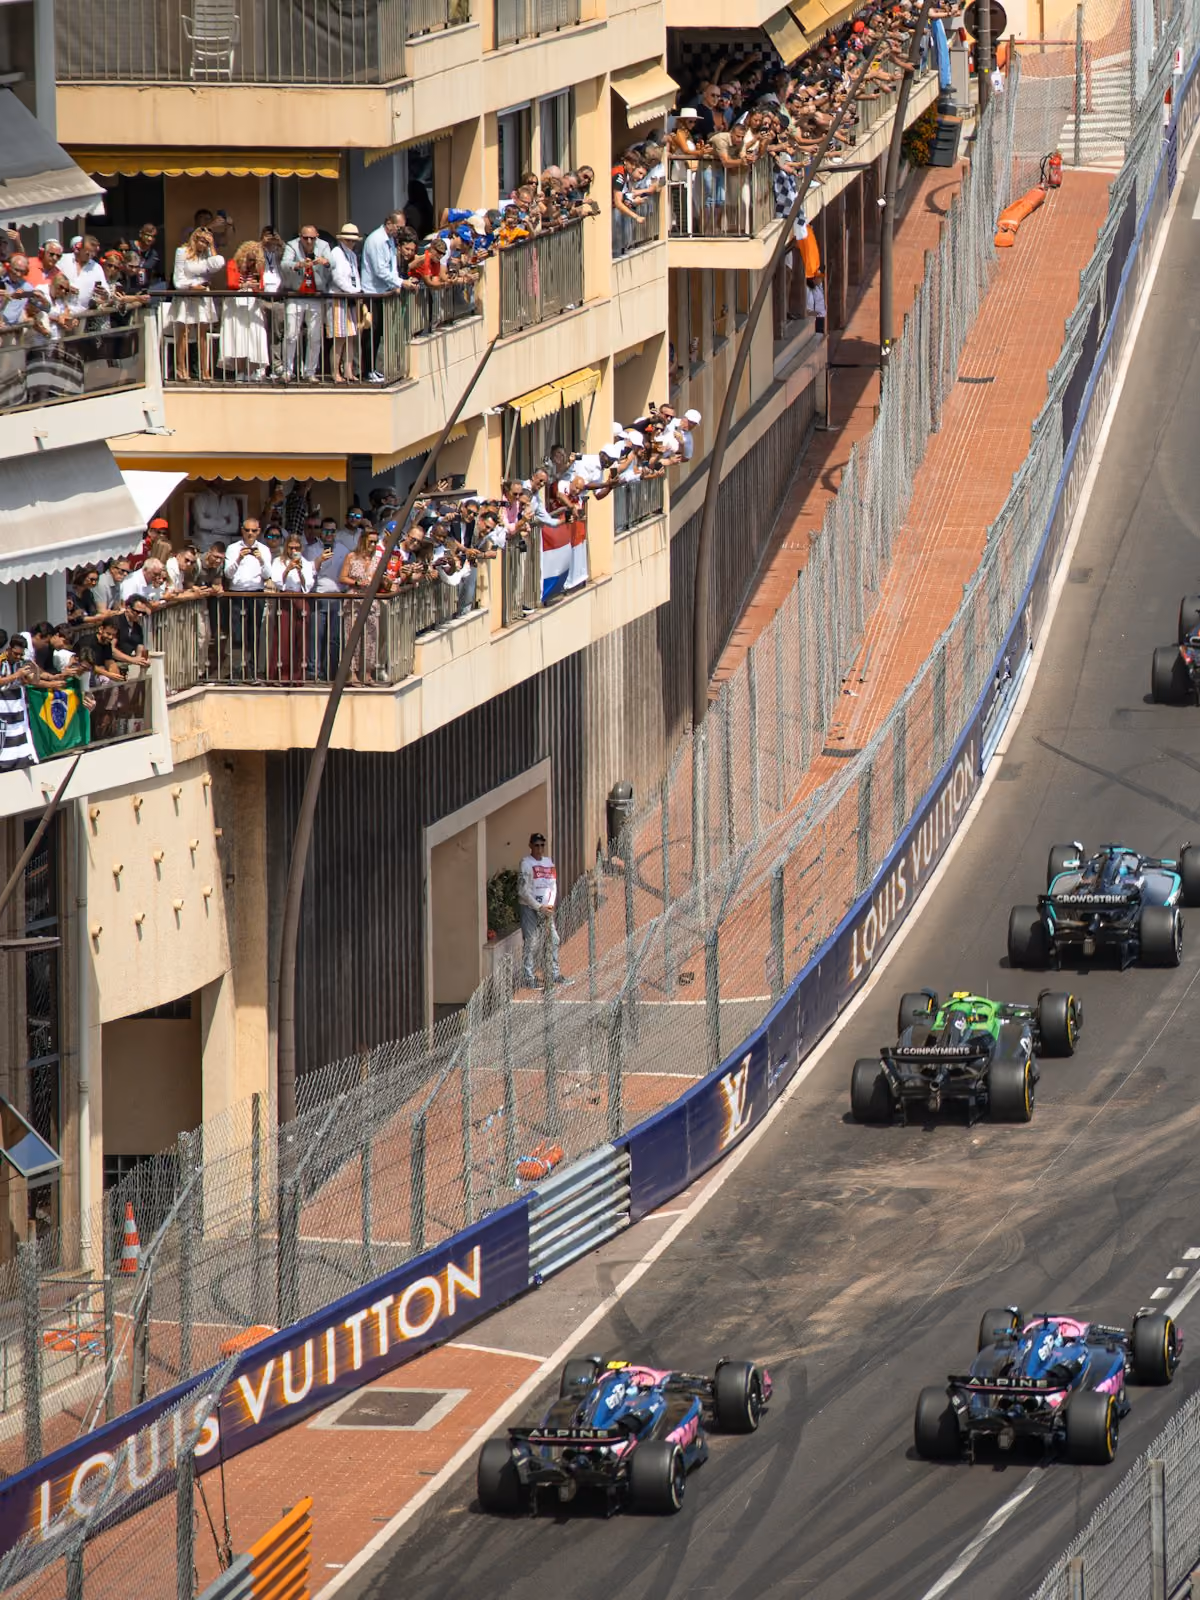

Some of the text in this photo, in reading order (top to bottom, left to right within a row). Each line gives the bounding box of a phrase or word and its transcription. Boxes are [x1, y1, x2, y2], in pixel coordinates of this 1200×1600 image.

[851, 738, 974, 979] LOUIS VUITTON
[1056, 894, 1128, 903] CROWDSTRIKE
[903, 1046, 970, 1055] COINPAYMENTS
[969, 1376, 1048, 1388] ALPINE
[40, 1244, 481, 1541] LOUIS VUITTON
[529, 1428, 609, 1438] ALPINE
